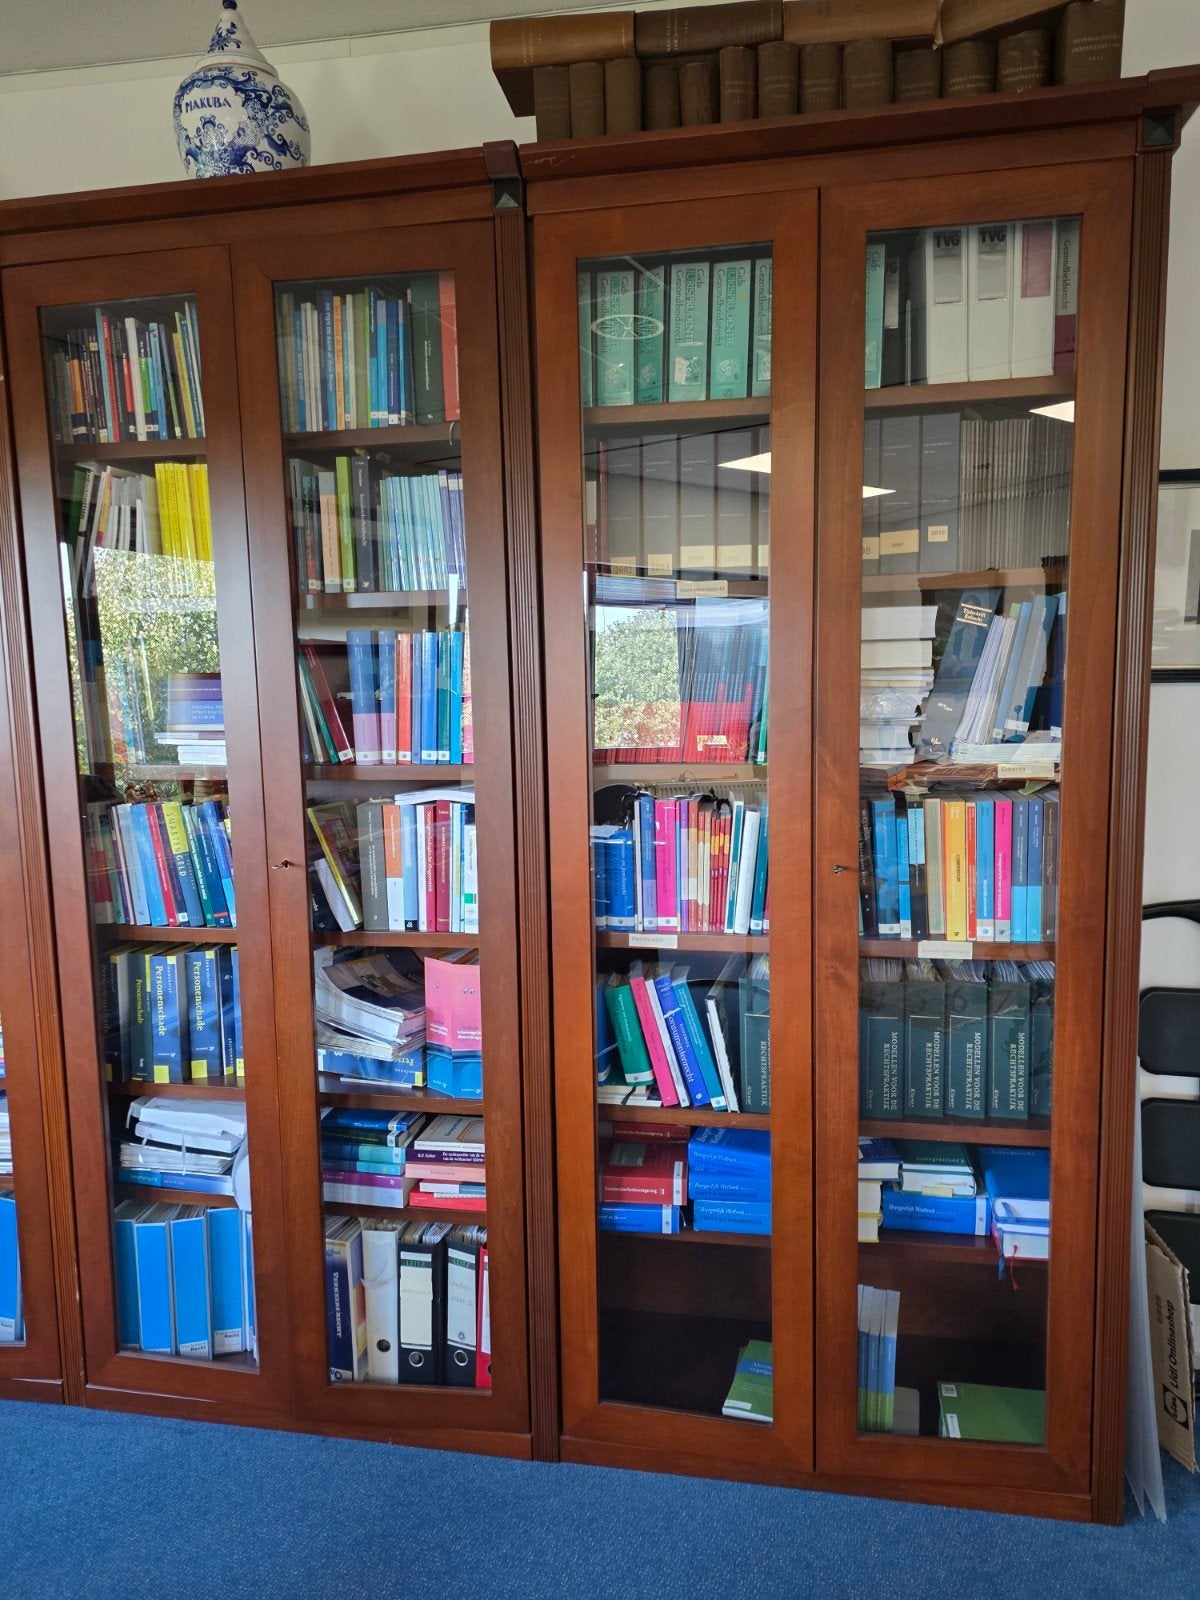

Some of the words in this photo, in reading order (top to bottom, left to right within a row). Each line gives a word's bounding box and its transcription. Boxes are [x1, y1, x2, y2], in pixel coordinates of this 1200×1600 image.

[934, 233, 961, 248] TVG
[979, 229, 1006, 244] TVG
[696, 268, 705, 288] Gids
[737, 267, 746, 287] Gids
[1062, 239, 1071, 309] Gezondheidsrecht
[685, 268, 696, 347] JURISPRUDENTIE
[715, 269, 726, 346] Gezondheidsrecht
[725, 266, 737, 347] JURISPRUDENTIE
[166, 812, 182, 852] SMARTEN
[176, 854, 187, 877] GELD
[136, 979, 144, 1024] Personenschade
[155, 965, 167, 1036] Personenschade
[193, 961, 206, 1031] Personenschade
[668, 1012, 695, 1083] Consumentenrecht
[890, 1032, 898, 1075] MODELLEN
[932, 1031, 940, 1074] MODELLEN
[973, 1032, 981, 1075] MODELLEN
[1017, 1032, 1025, 1075] MODELLEN
[890, 1077, 898, 1097] VOOR
[932, 1076, 940, 1097] VOOR
[965, 1043, 974, 1110] RECHTSPRAKTIJK
[973, 1077, 981, 1098] VOOR
[1009, 1043, 1017, 1111] RECHTSPRAKTIJK
[1017, 1077, 1025, 1098] VOOR
[890, 1099, 898, 1111] DE
[932, 1099, 940, 1109] DE
[973, 1099, 981, 1111] DE
[1017, 1100, 1025, 1111] DE
[700, 1206, 725, 1214] Burgerlijk
[888, 1204, 915, 1213] Burgerlijk
[915, 1205, 935, 1214] Wetboek
[453, 1258, 471, 1268] LEITZ
[332, 1271, 342, 1338] VERKEERSRECHT
[1166, 1300, 1179, 1365] Onlineshop
[1167, 1364, 1179, 1390] Lidl
